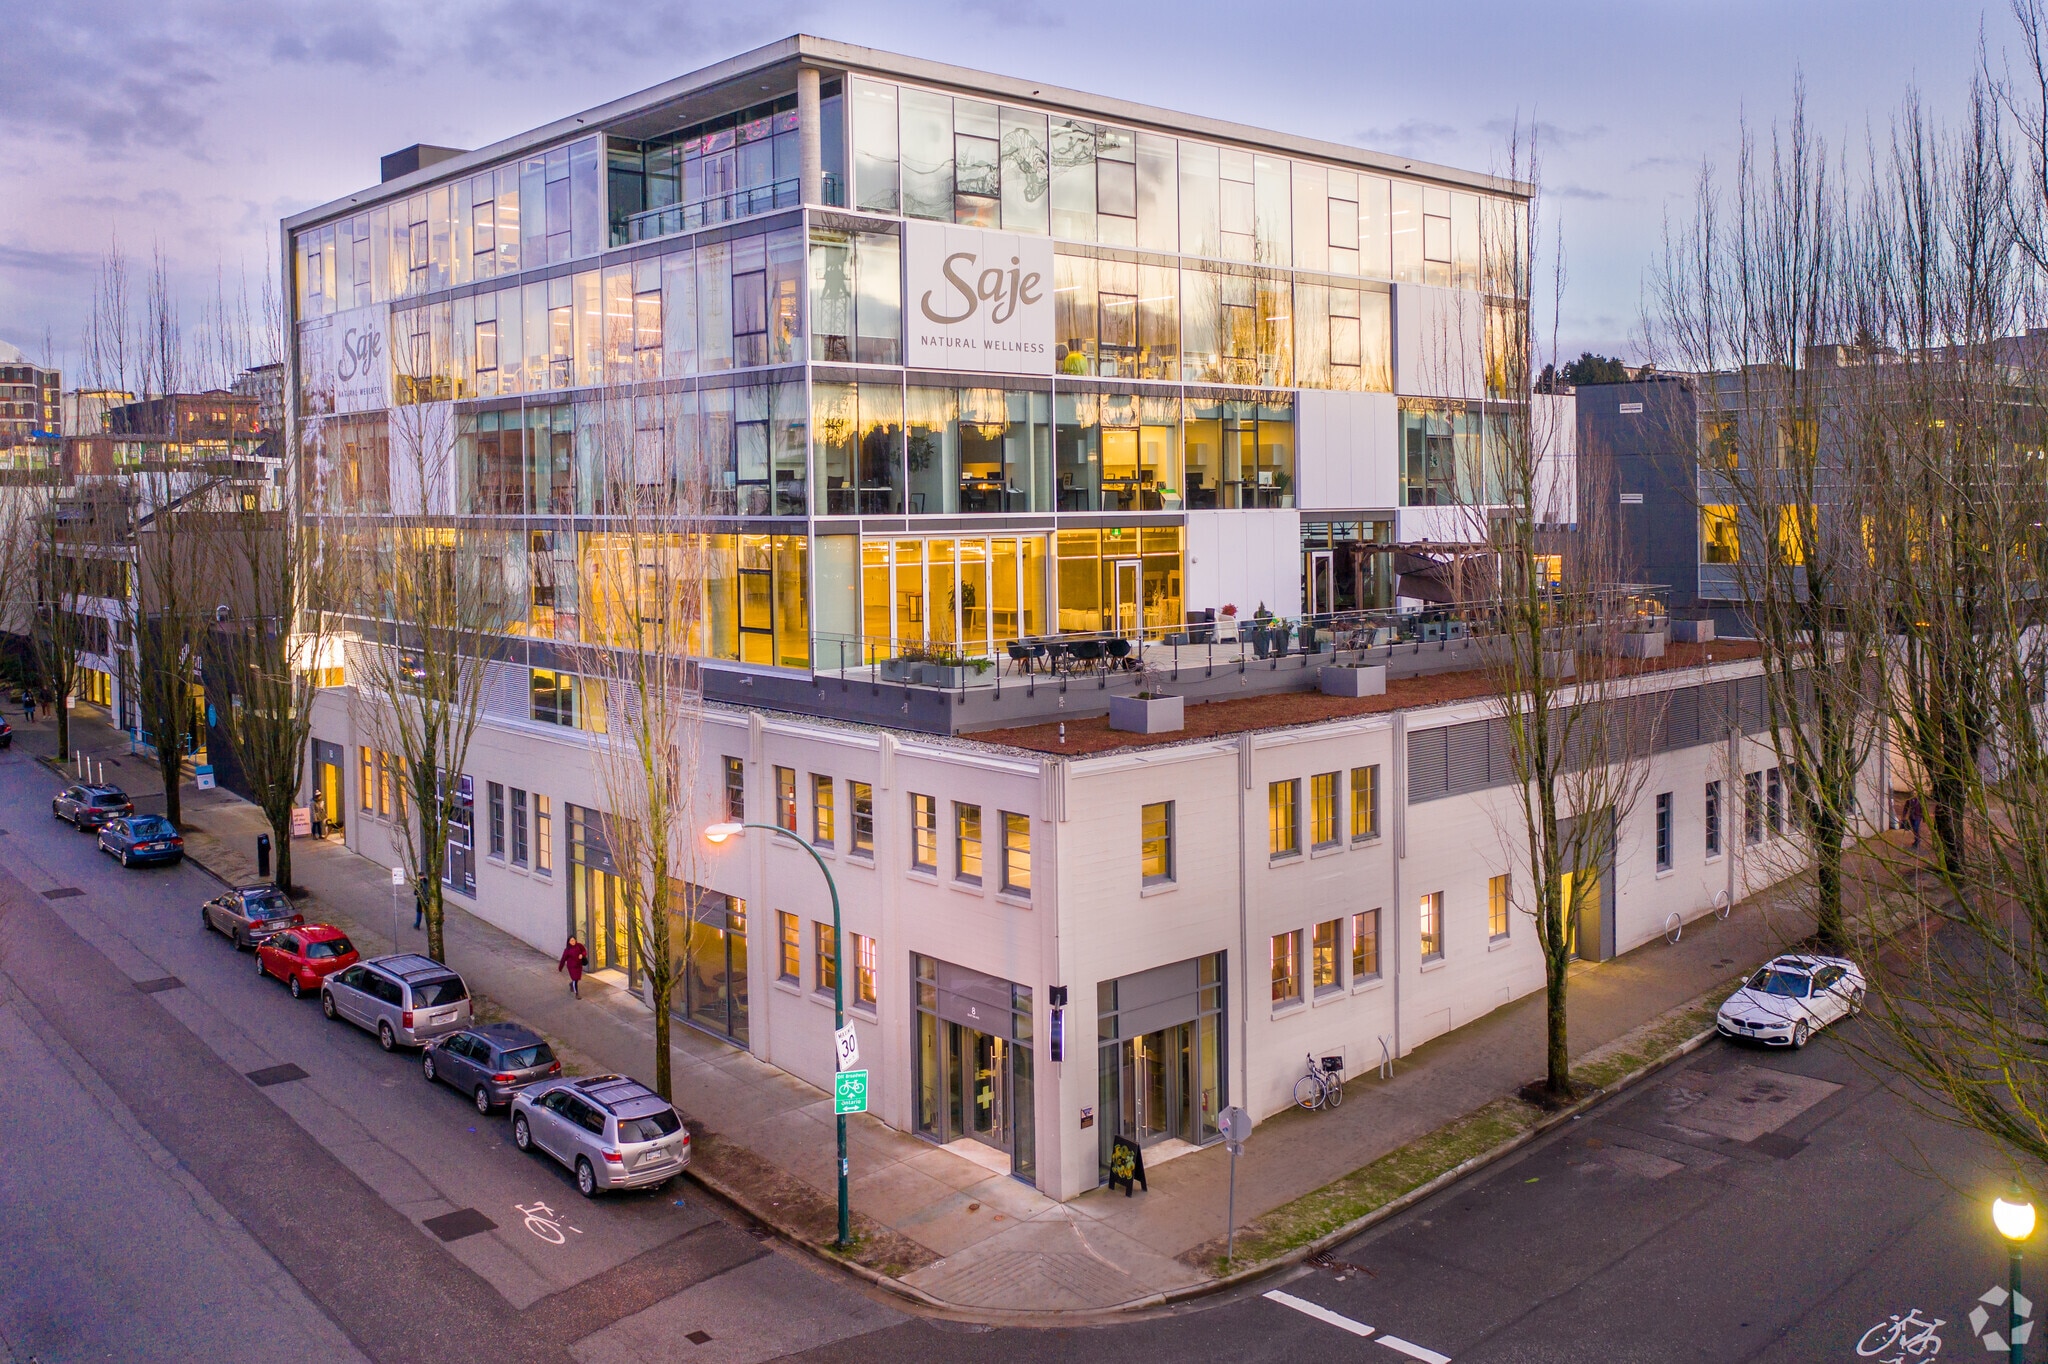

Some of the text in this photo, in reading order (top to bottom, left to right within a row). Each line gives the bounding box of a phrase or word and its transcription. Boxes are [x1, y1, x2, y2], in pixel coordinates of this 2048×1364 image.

[921, 252, 1043, 324] Saje
[338, 323, 382, 382] Saje
[921, 335, 1045, 354] NATURAL WELLNESS
[971, 1006, 976, 1015] 8
[841, 1034, 856, 1058] 30
